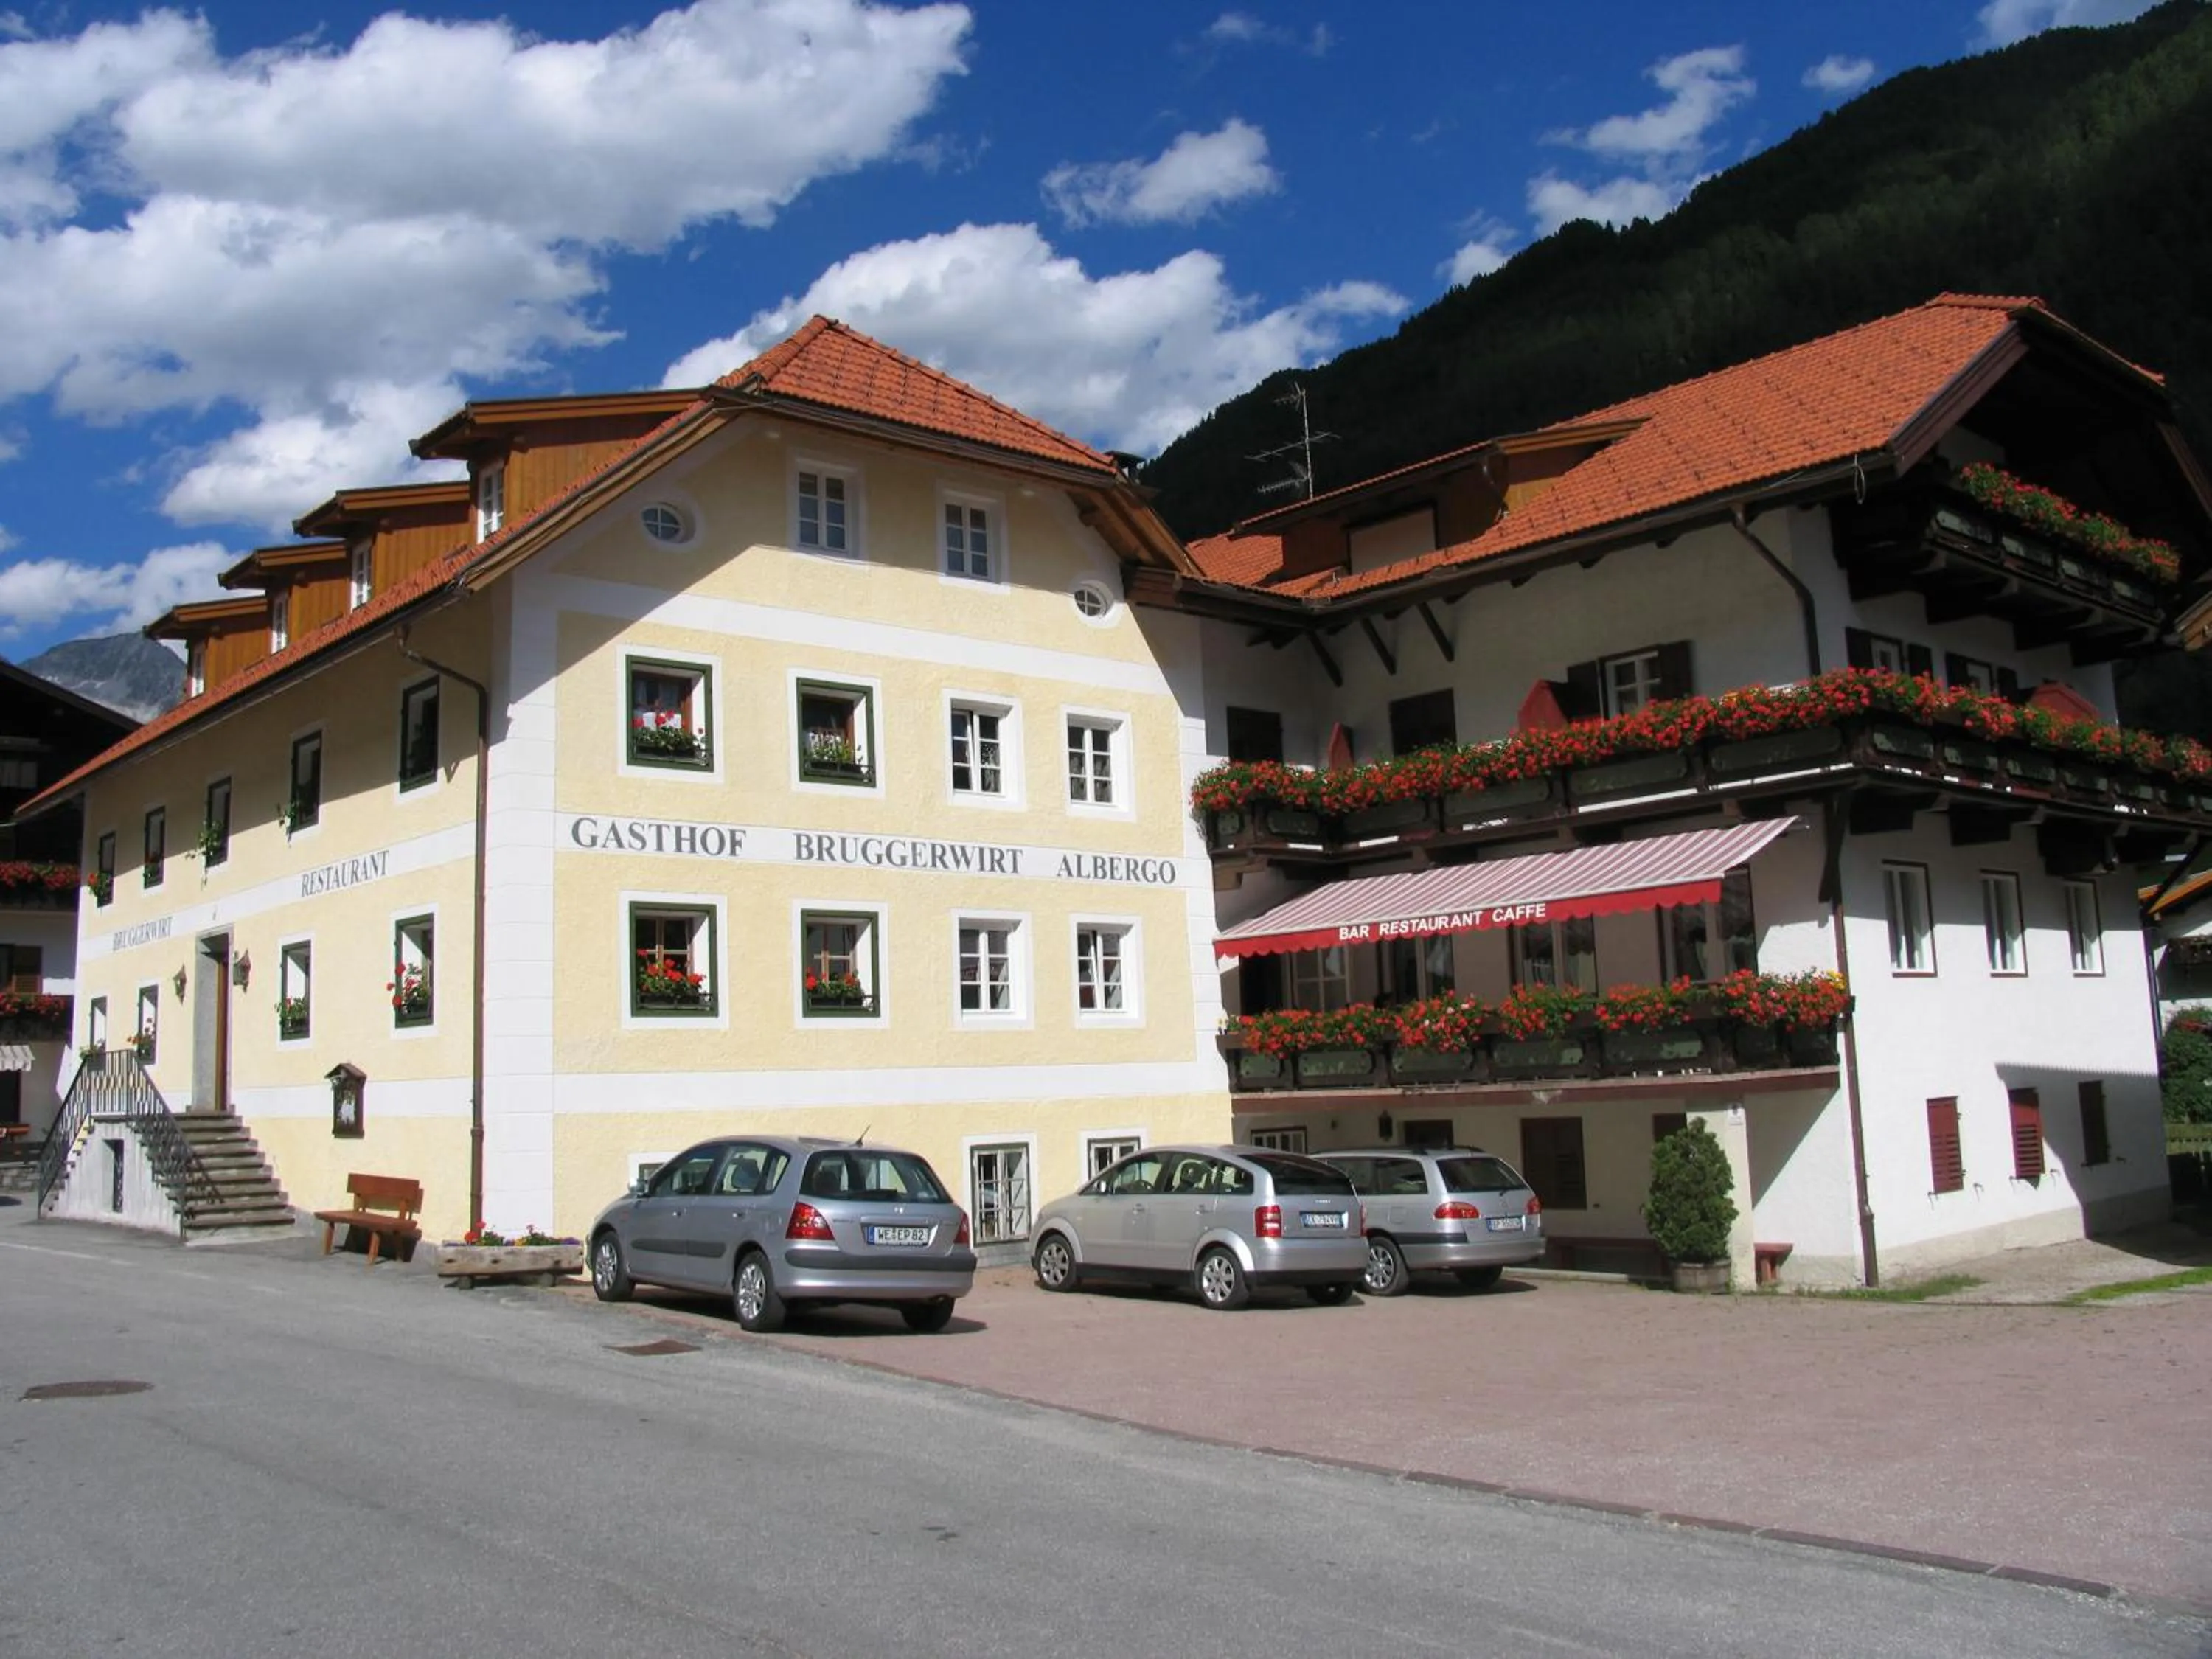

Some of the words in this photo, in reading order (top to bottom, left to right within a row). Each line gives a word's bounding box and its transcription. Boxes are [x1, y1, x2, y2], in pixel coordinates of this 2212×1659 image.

[571, 816, 748, 858] GASTHOF
[793, 832, 1024, 876] BRUGGERWIRT
[1057, 855, 1177, 885] ALBERGO
[301, 850, 390, 897] RESTAURANT
[113, 916, 173, 952] BRUGGERWIRT
[1339, 925, 1370, 941] BAR
[1380, 911, 1484, 936] RESTAURANT
[1492, 902, 1546, 923] CAFFE
